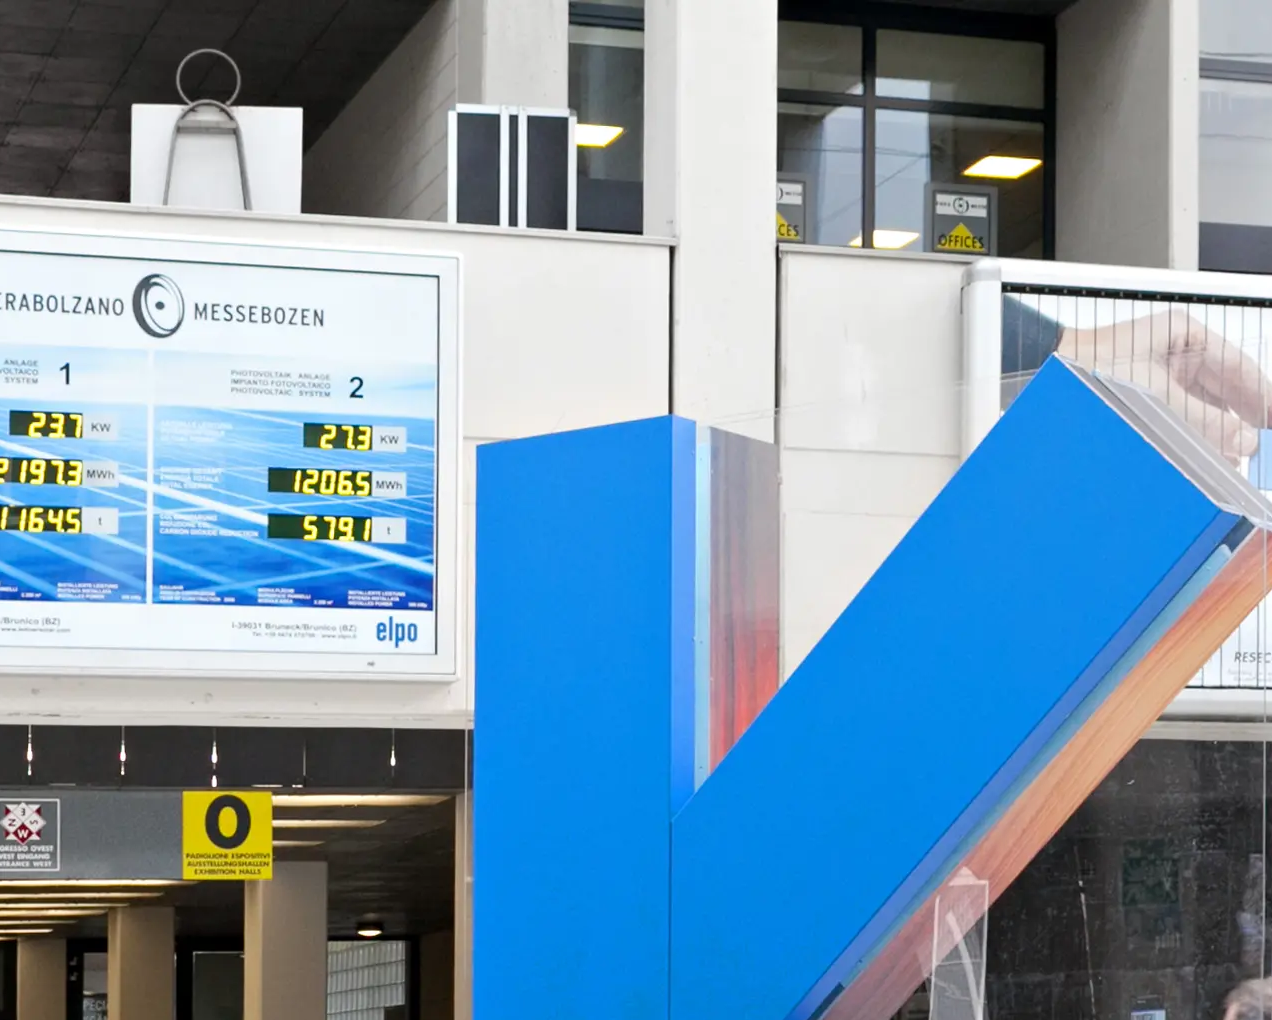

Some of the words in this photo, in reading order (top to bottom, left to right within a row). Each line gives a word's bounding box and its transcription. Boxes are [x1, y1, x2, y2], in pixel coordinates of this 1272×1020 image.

[938, 234, 985, 249] OFFICES
[194, 302, 325, 327] MESSEBOZEN
[4, 359, 39, 367] ANLAGE
[59, 362, 70, 385] 1
[5, 376, 39, 384] SYSTEM
[230, 378, 269, 386] IMPIANTO
[270, 380, 331, 389] FOTOVOLTAICO
[230, 387, 292, 396] PHOTOVOLTAIC
[299, 390, 331, 398] SYSTEM
[349, 376, 364, 398] 2
[90, 422, 111, 433] KW
[379, 435, 399, 445] KW
[86, 469, 115, 480] MWh
[375, 480, 403, 491] MWh
[97, 516, 102, 526] t
[387, 525, 391, 535] t
[41, 617, 61, 626] (BZ)
[264, 622, 337, 631] Bruneck/Brunico
[339, 624, 357, 633] (BZ)
[376, 616, 418, 649] elpo
[30, 844, 54, 853] OVEST
[185, 852, 229, 860] PADIGLIONI
[231, 852, 271, 860] ESPOSITIVI
